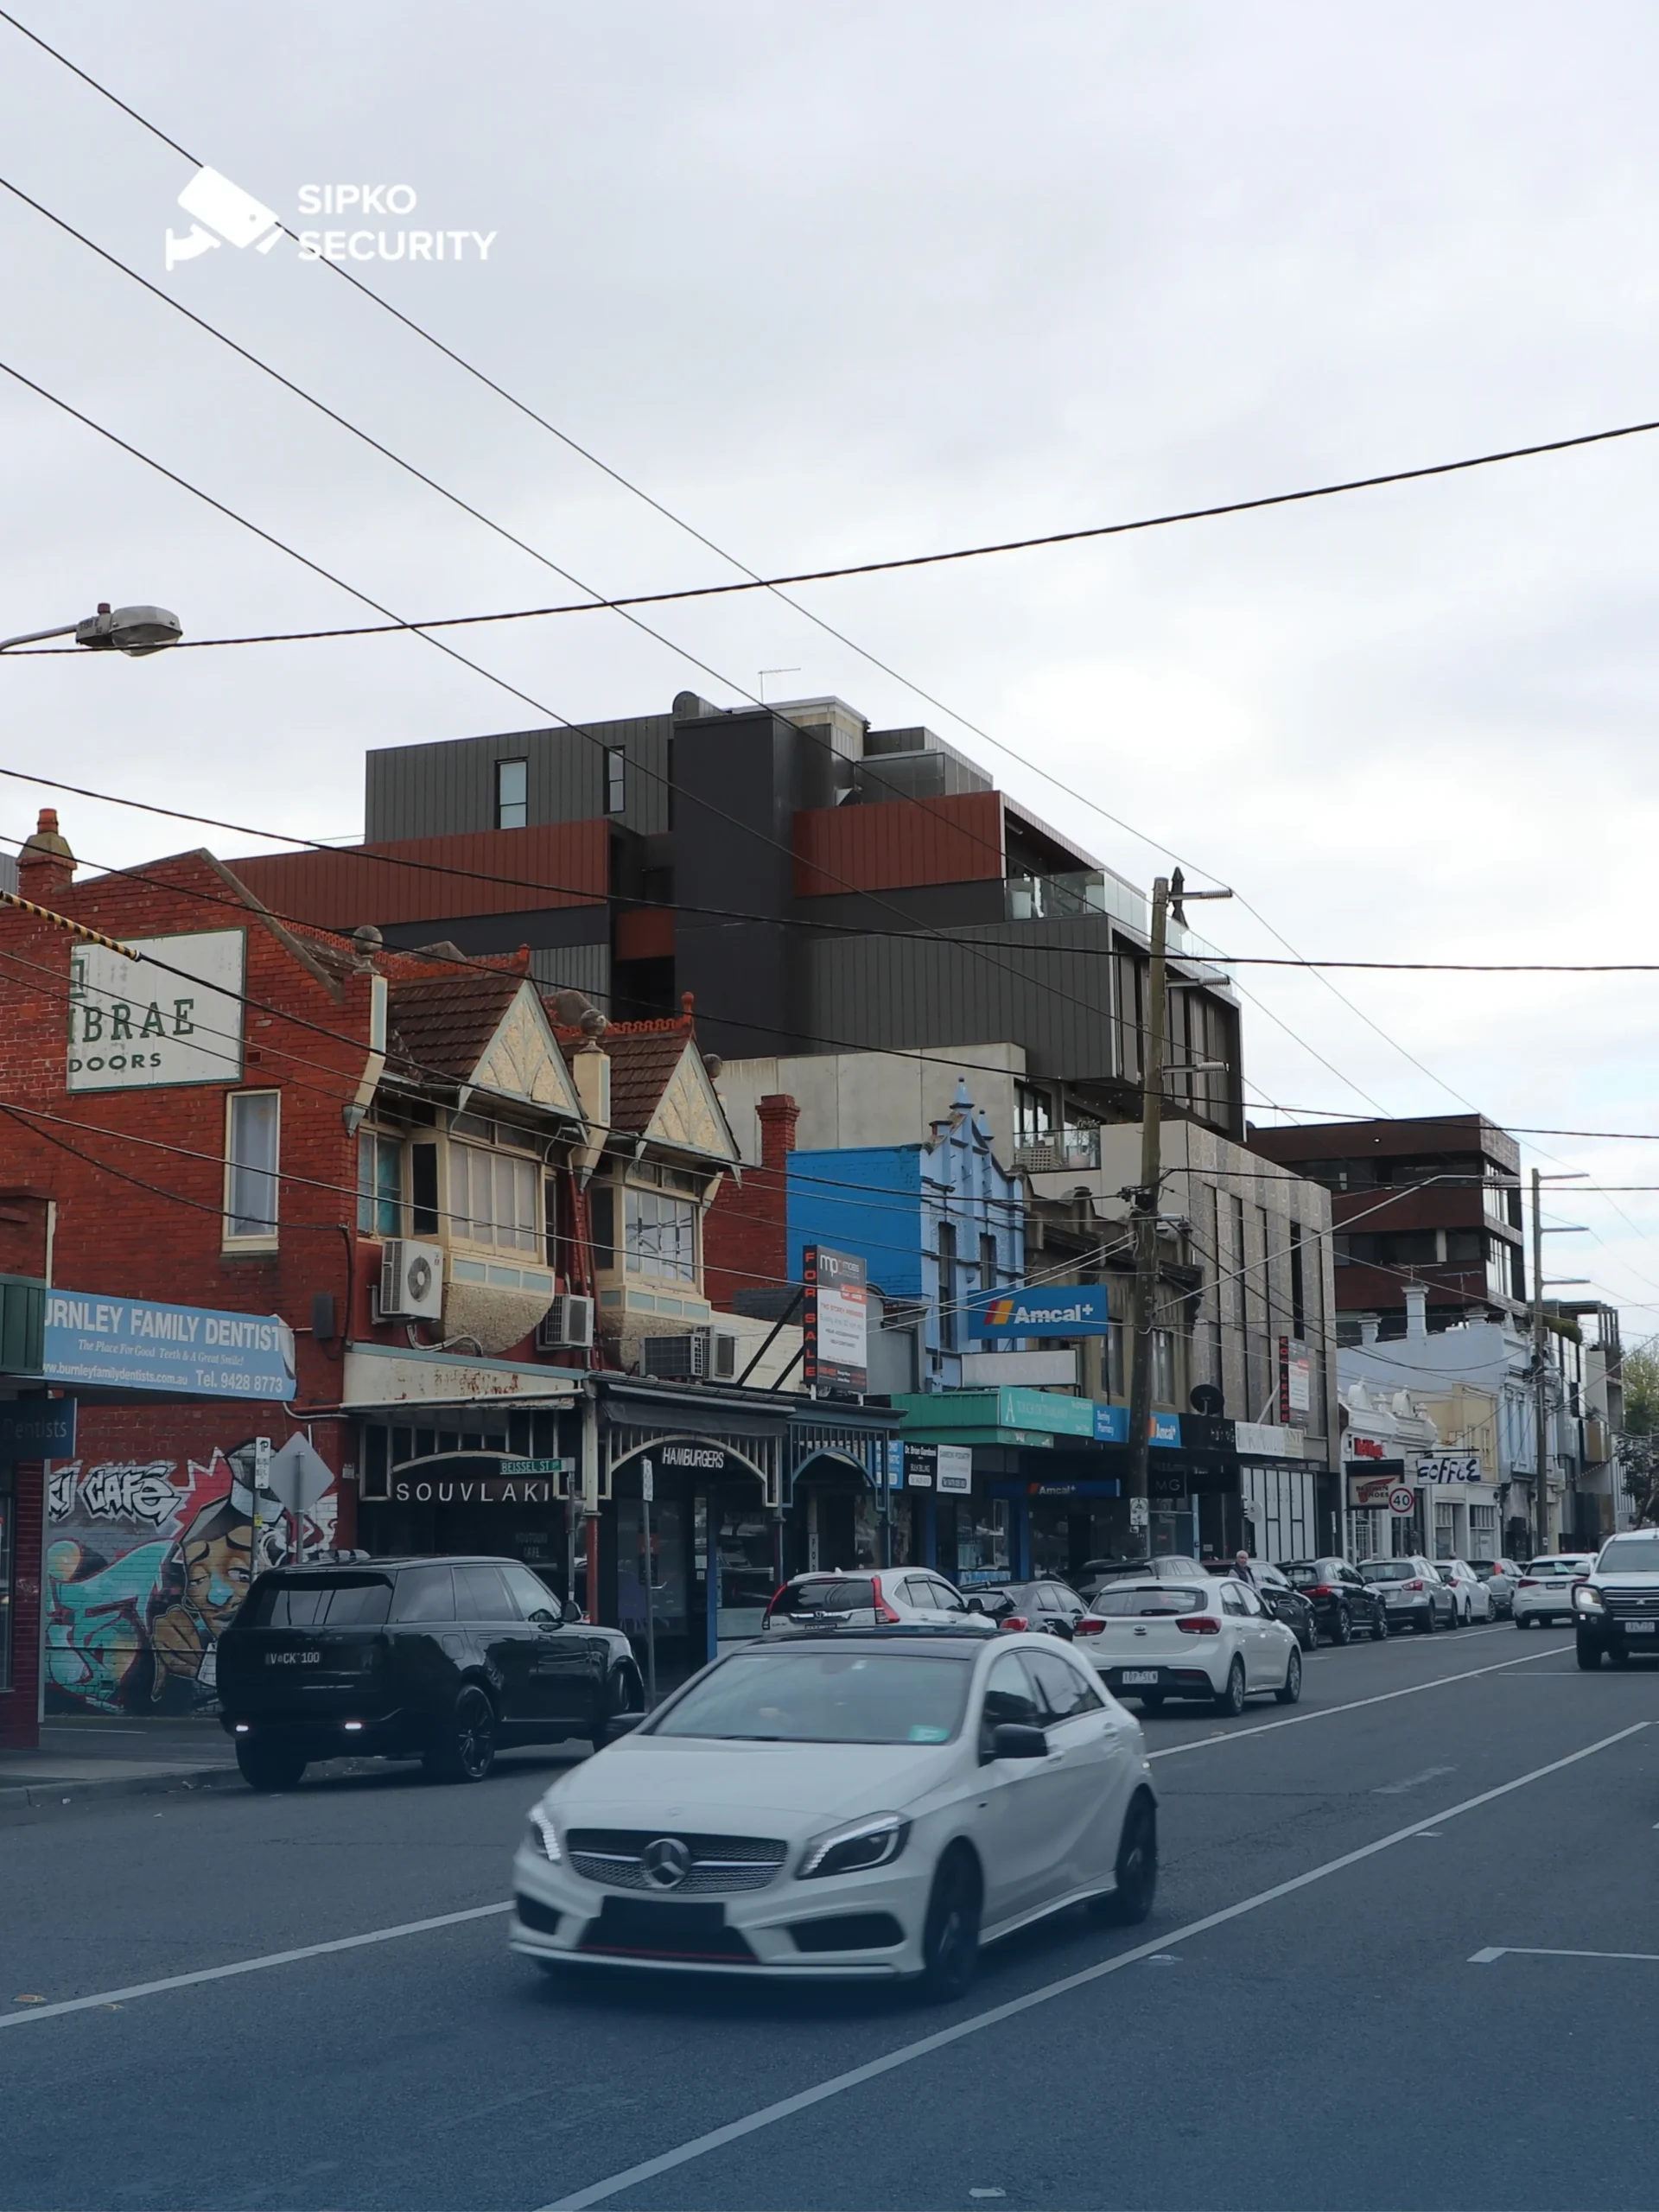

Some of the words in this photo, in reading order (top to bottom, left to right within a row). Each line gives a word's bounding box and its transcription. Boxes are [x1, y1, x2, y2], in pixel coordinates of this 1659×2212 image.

[130, 1308, 200, 1343] FAMILY
[79, 1338, 94, 1351] The
[96, 1340, 118, 1354] Place
[120, 1344, 134, 1356] For
[134, 1344, 156, 1357] Good
[159, 1347, 181, 1361] Teeth
[198, 1351, 219, 1364] Great
[805, 1313, 817, 1377] SALE
[220, 1371, 250, 1391] 9428
[254, 1375, 283, 1393] 8773
[502, 1461, 537, 1472] BEISSEL
[540, 1460, 550, 1471] ST
[662, 1446, 724, 1468] HAMBURGERS
[397, 1483, 550, 1502] SOUVLAKI
[1394, 1495, 1410, 1505] 40
